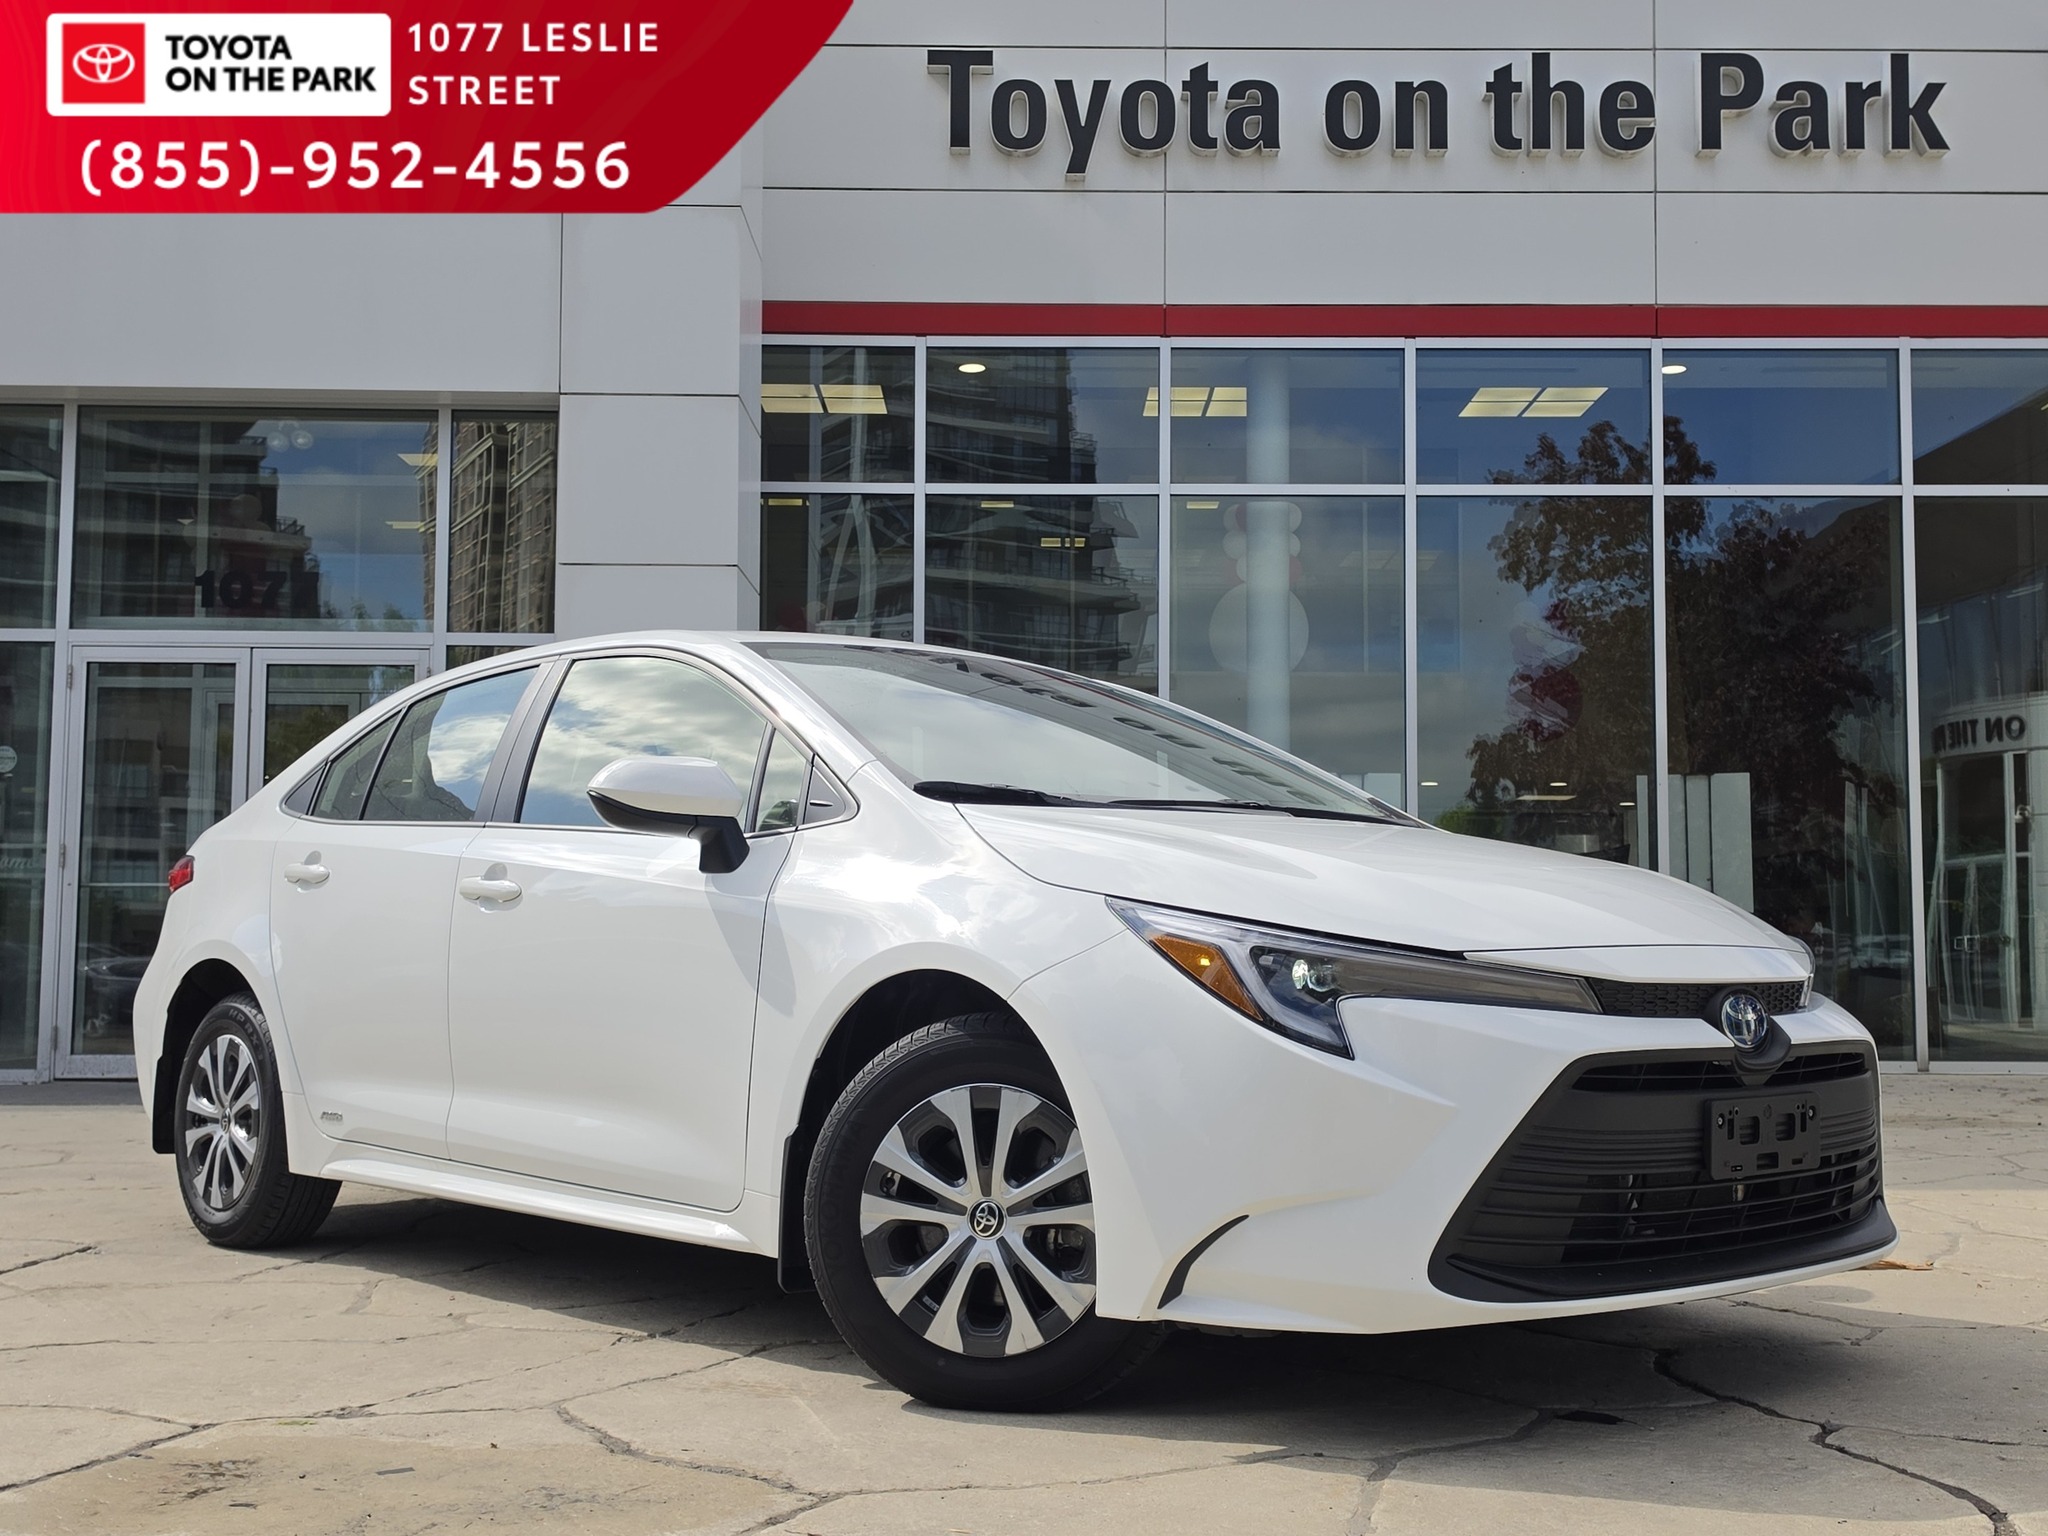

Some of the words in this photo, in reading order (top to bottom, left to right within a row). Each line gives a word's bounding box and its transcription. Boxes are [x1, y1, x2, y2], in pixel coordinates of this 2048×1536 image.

[928, 49, 1280, 178] Toyota
[1325, 79, 1448, 156] on
[1485, 52, 1657, 156] the
[1698, 52, 1948, 156] Park
